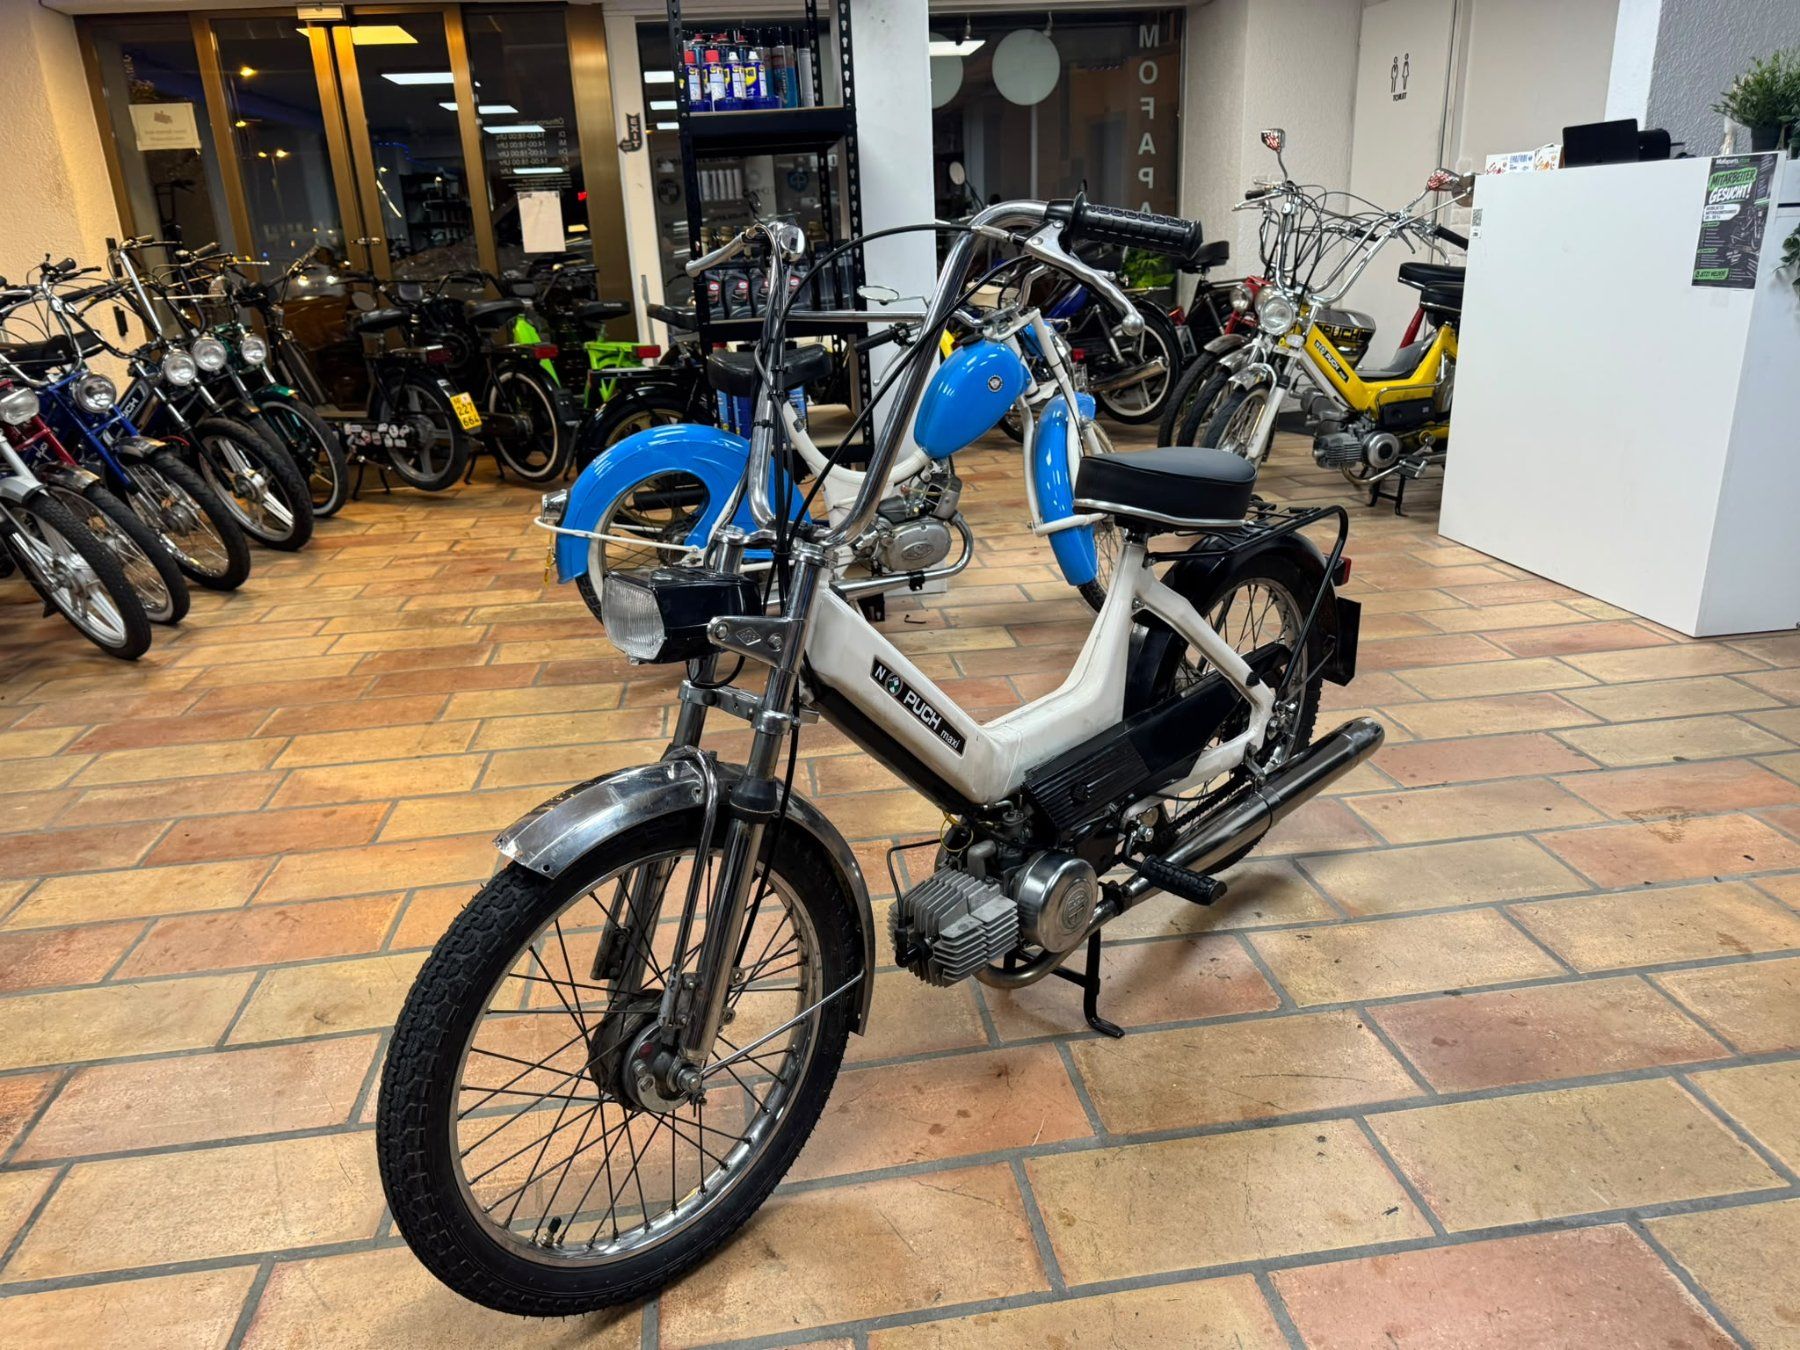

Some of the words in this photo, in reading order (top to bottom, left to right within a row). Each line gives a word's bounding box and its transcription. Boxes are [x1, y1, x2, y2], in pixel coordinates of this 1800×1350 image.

[629, 117, 640, 148] EXIT
[1712, 170, 1756, 186] MITARBEITER
[1709, 183, 1752, 203] GESUCHT!
[456, 402, 474, 416] 227
[874, 665, 886, 680] N
[903, 690, 942, 731] PUCH
[940, 729, 961, 749] maxi
